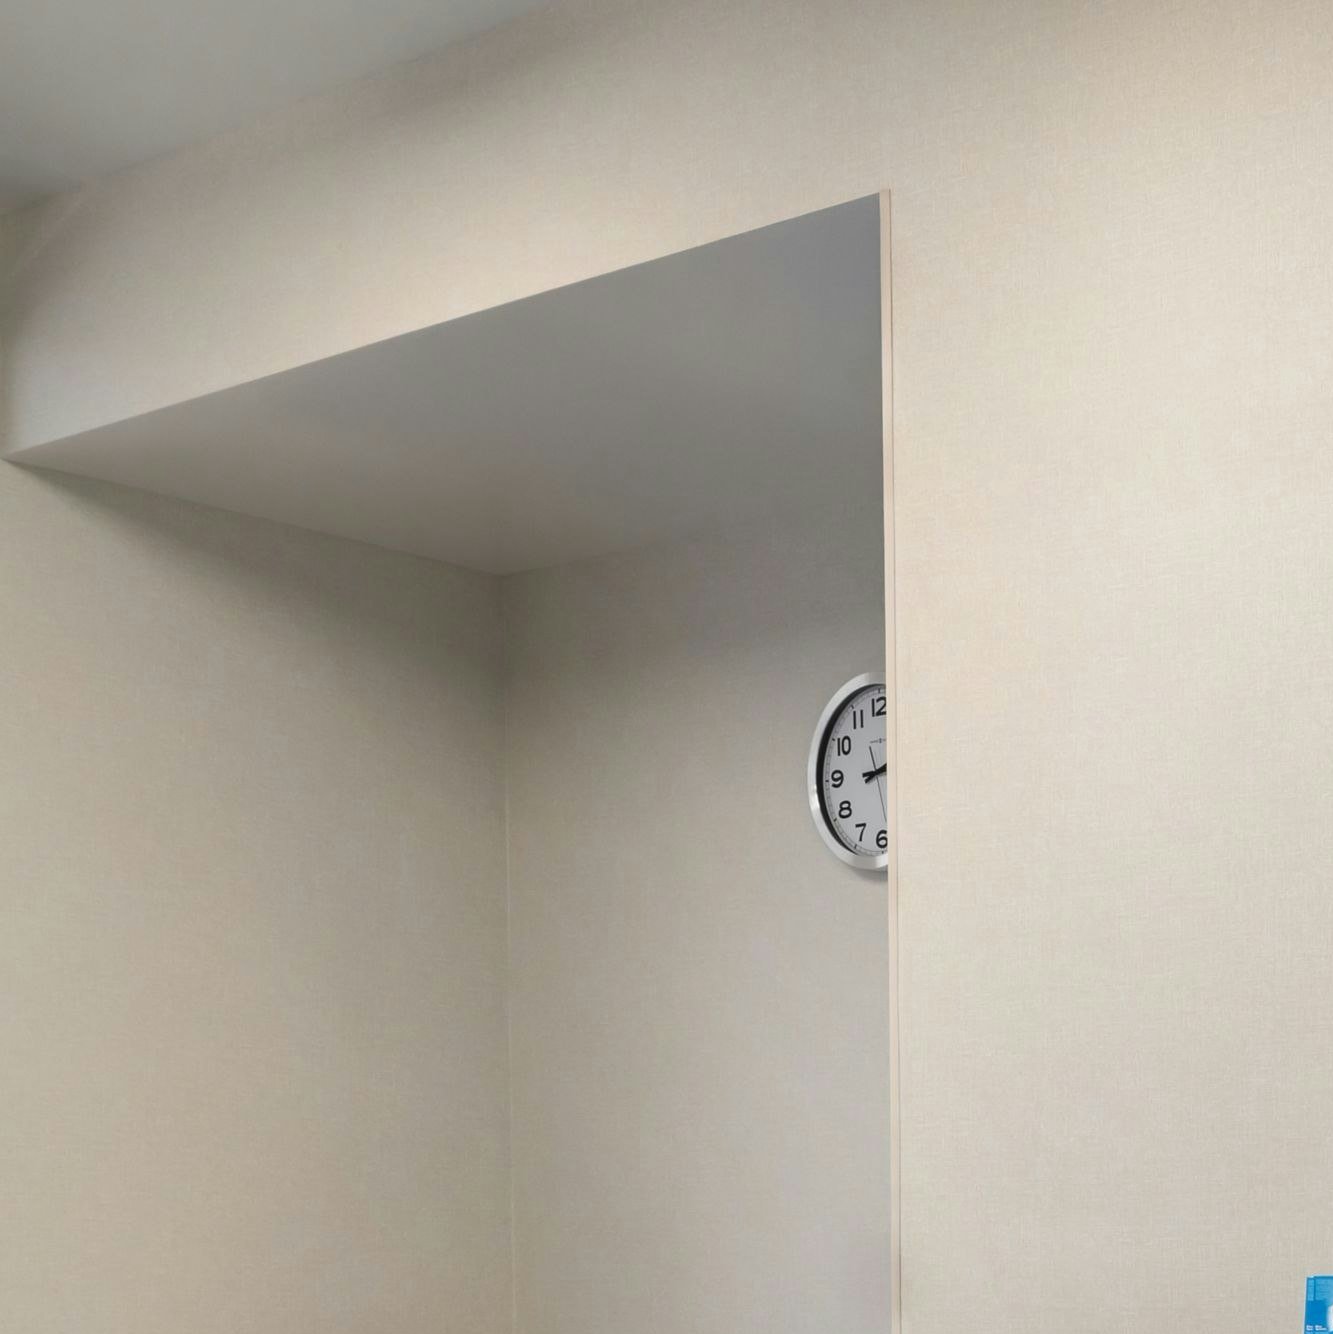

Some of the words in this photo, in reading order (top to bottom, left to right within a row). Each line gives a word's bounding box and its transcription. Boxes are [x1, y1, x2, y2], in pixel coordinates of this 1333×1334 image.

[872, 697, 886, 717] 12
[853, 710, 864, 729] 11
[837, 735, 851, 756] 10
[831, 770, 844, 788] 9
[839, 801, 852, 818] 8
[855, 823, 866, 841] 7
[876, 830, 888, 848] 6
